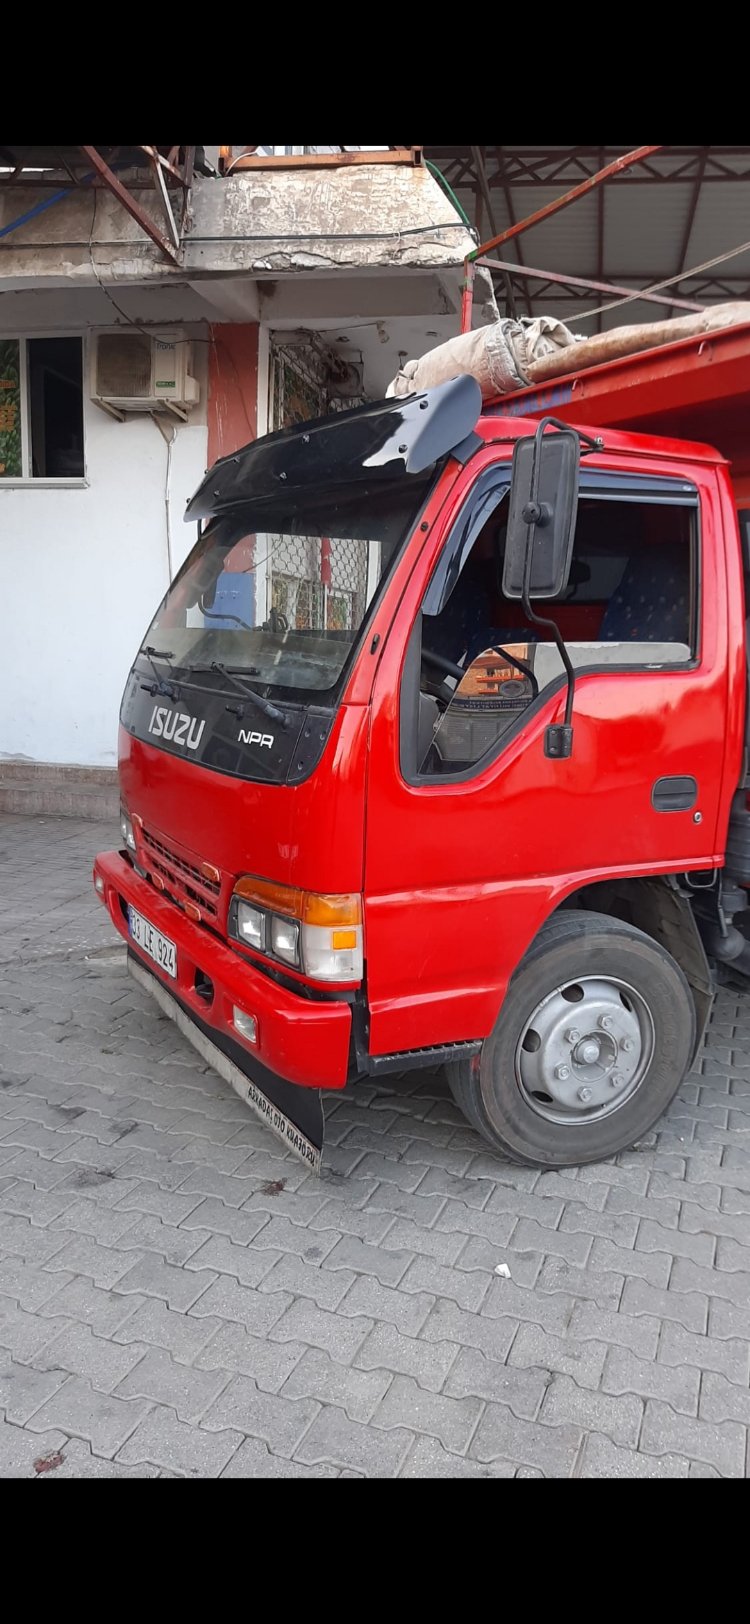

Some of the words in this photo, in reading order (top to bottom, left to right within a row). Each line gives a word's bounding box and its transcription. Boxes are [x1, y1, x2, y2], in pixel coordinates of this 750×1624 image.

[148, 705, 206, 750] ISUZU
[238, 729, 275, 749] NPR
[144, 925, 154, 953] LE
[158, 938, 174, 970] 924
[274, 1112, 286, 1133] OTO
